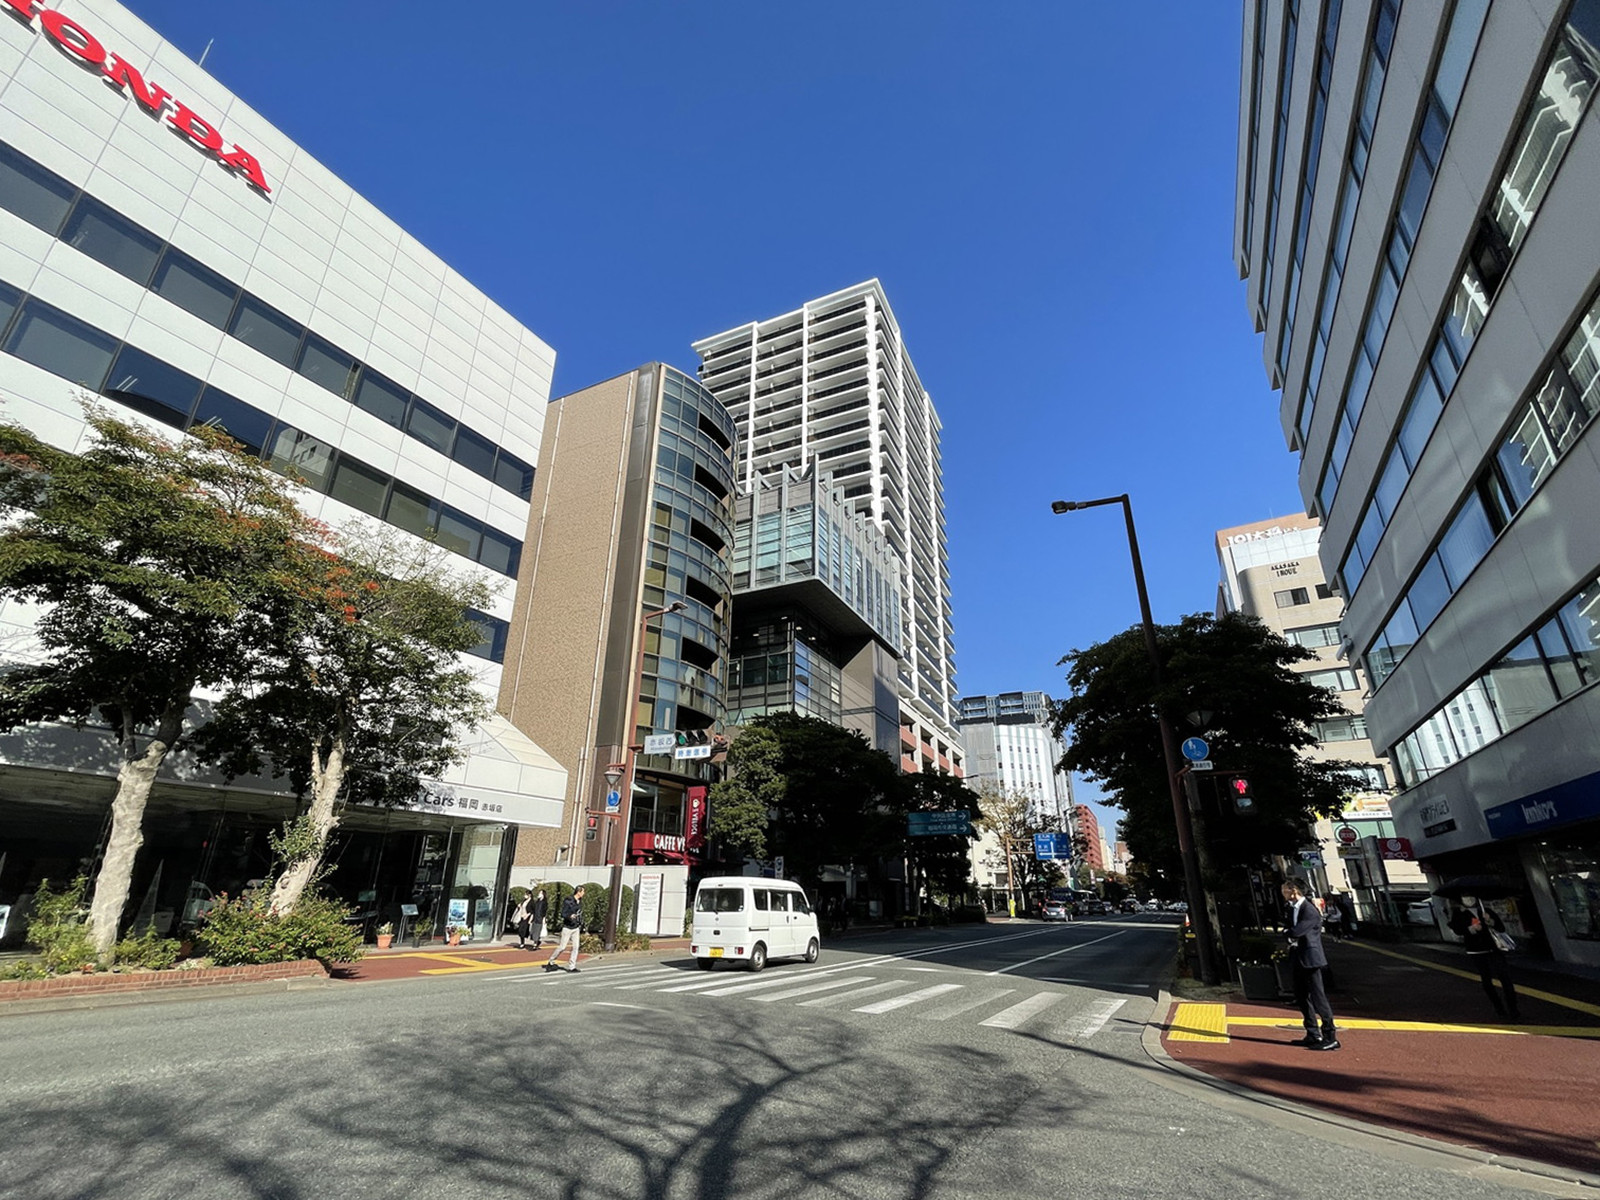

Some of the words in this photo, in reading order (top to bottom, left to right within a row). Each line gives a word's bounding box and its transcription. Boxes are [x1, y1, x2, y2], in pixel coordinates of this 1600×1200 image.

[1271, 561, 1300, 571] AKASAKA
[423, 791, 455, 807] Cars
[458, 797, 479, 810] 福岡
[481, 803, 503, 813] 赤坂店
